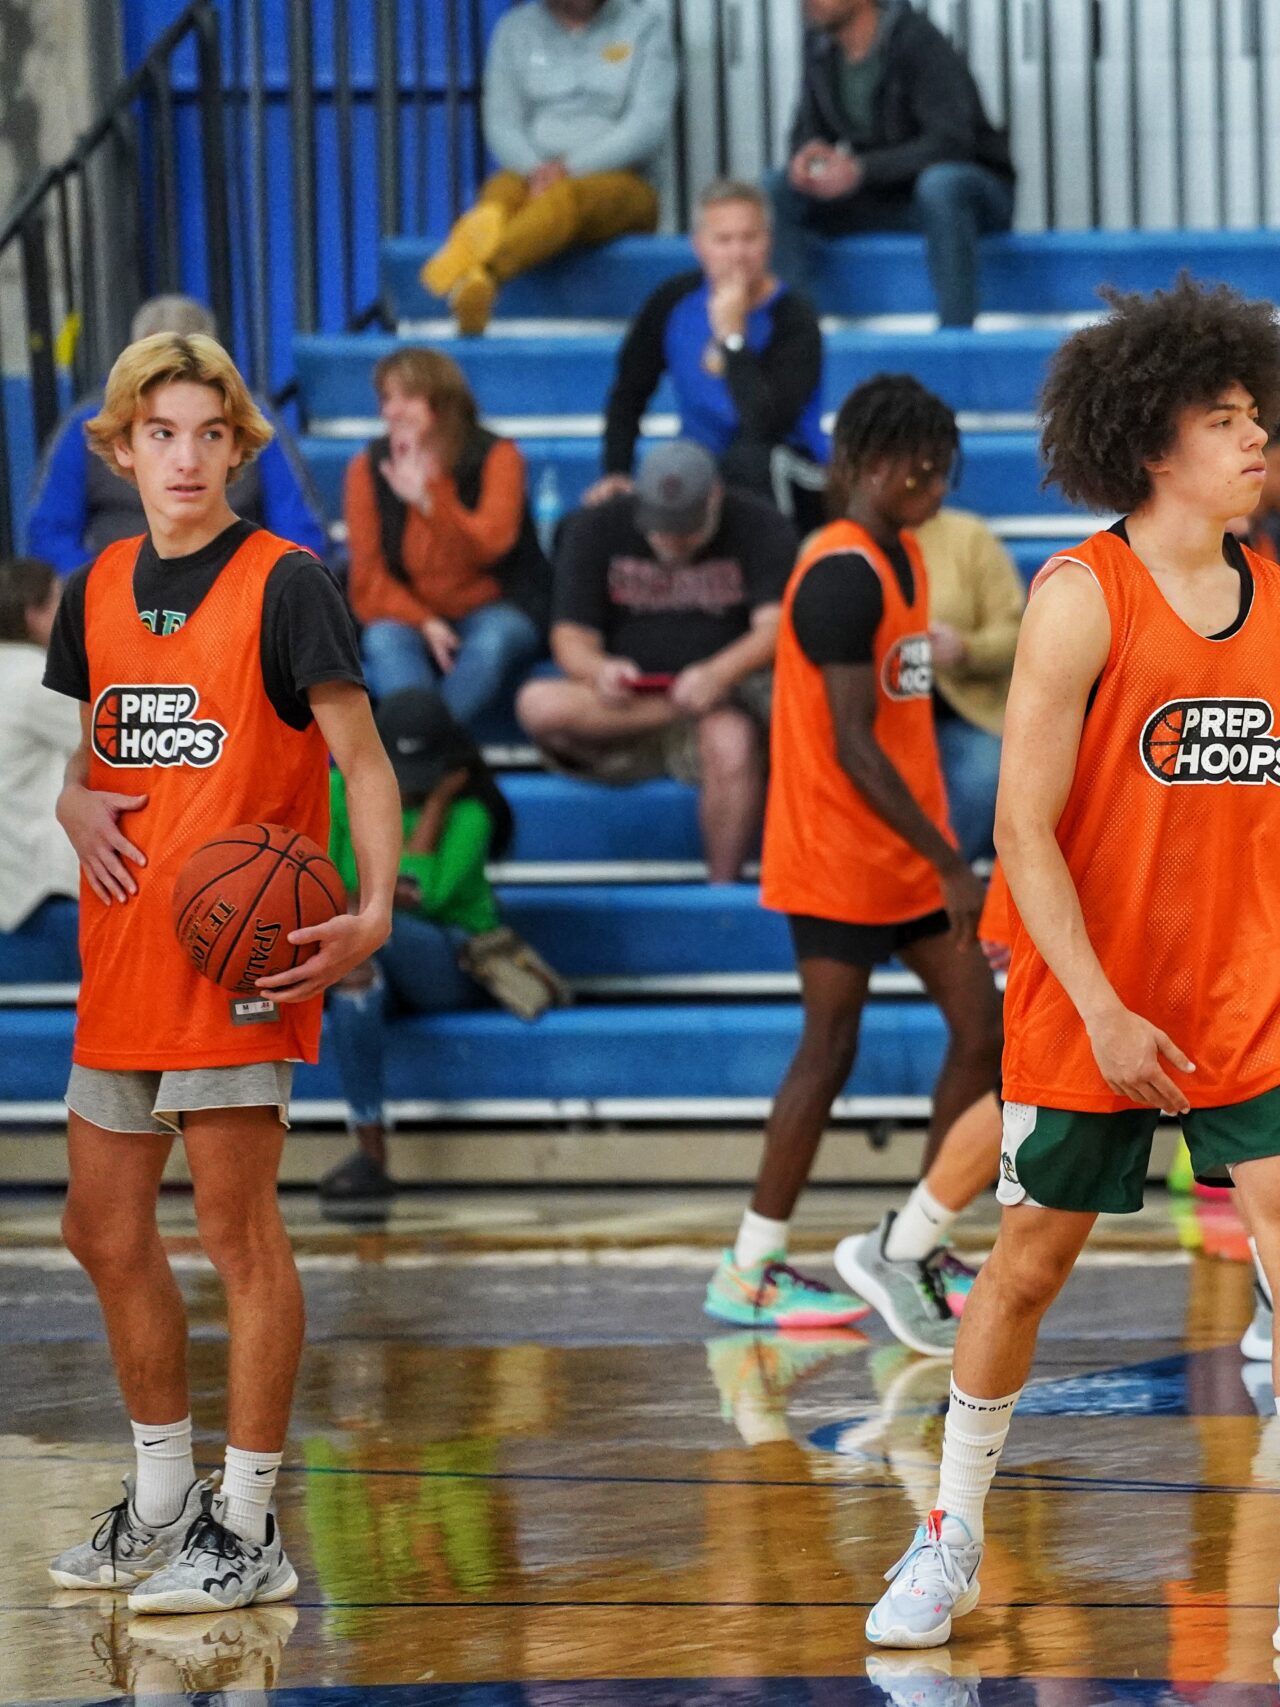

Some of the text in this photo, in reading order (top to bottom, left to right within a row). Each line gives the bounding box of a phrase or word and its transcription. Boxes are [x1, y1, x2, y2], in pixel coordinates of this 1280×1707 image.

[121, 693, 192, 724] PREP
[1181, 707, 1267, 739] PREP
[120, 727, 217, 759] HOOPS
